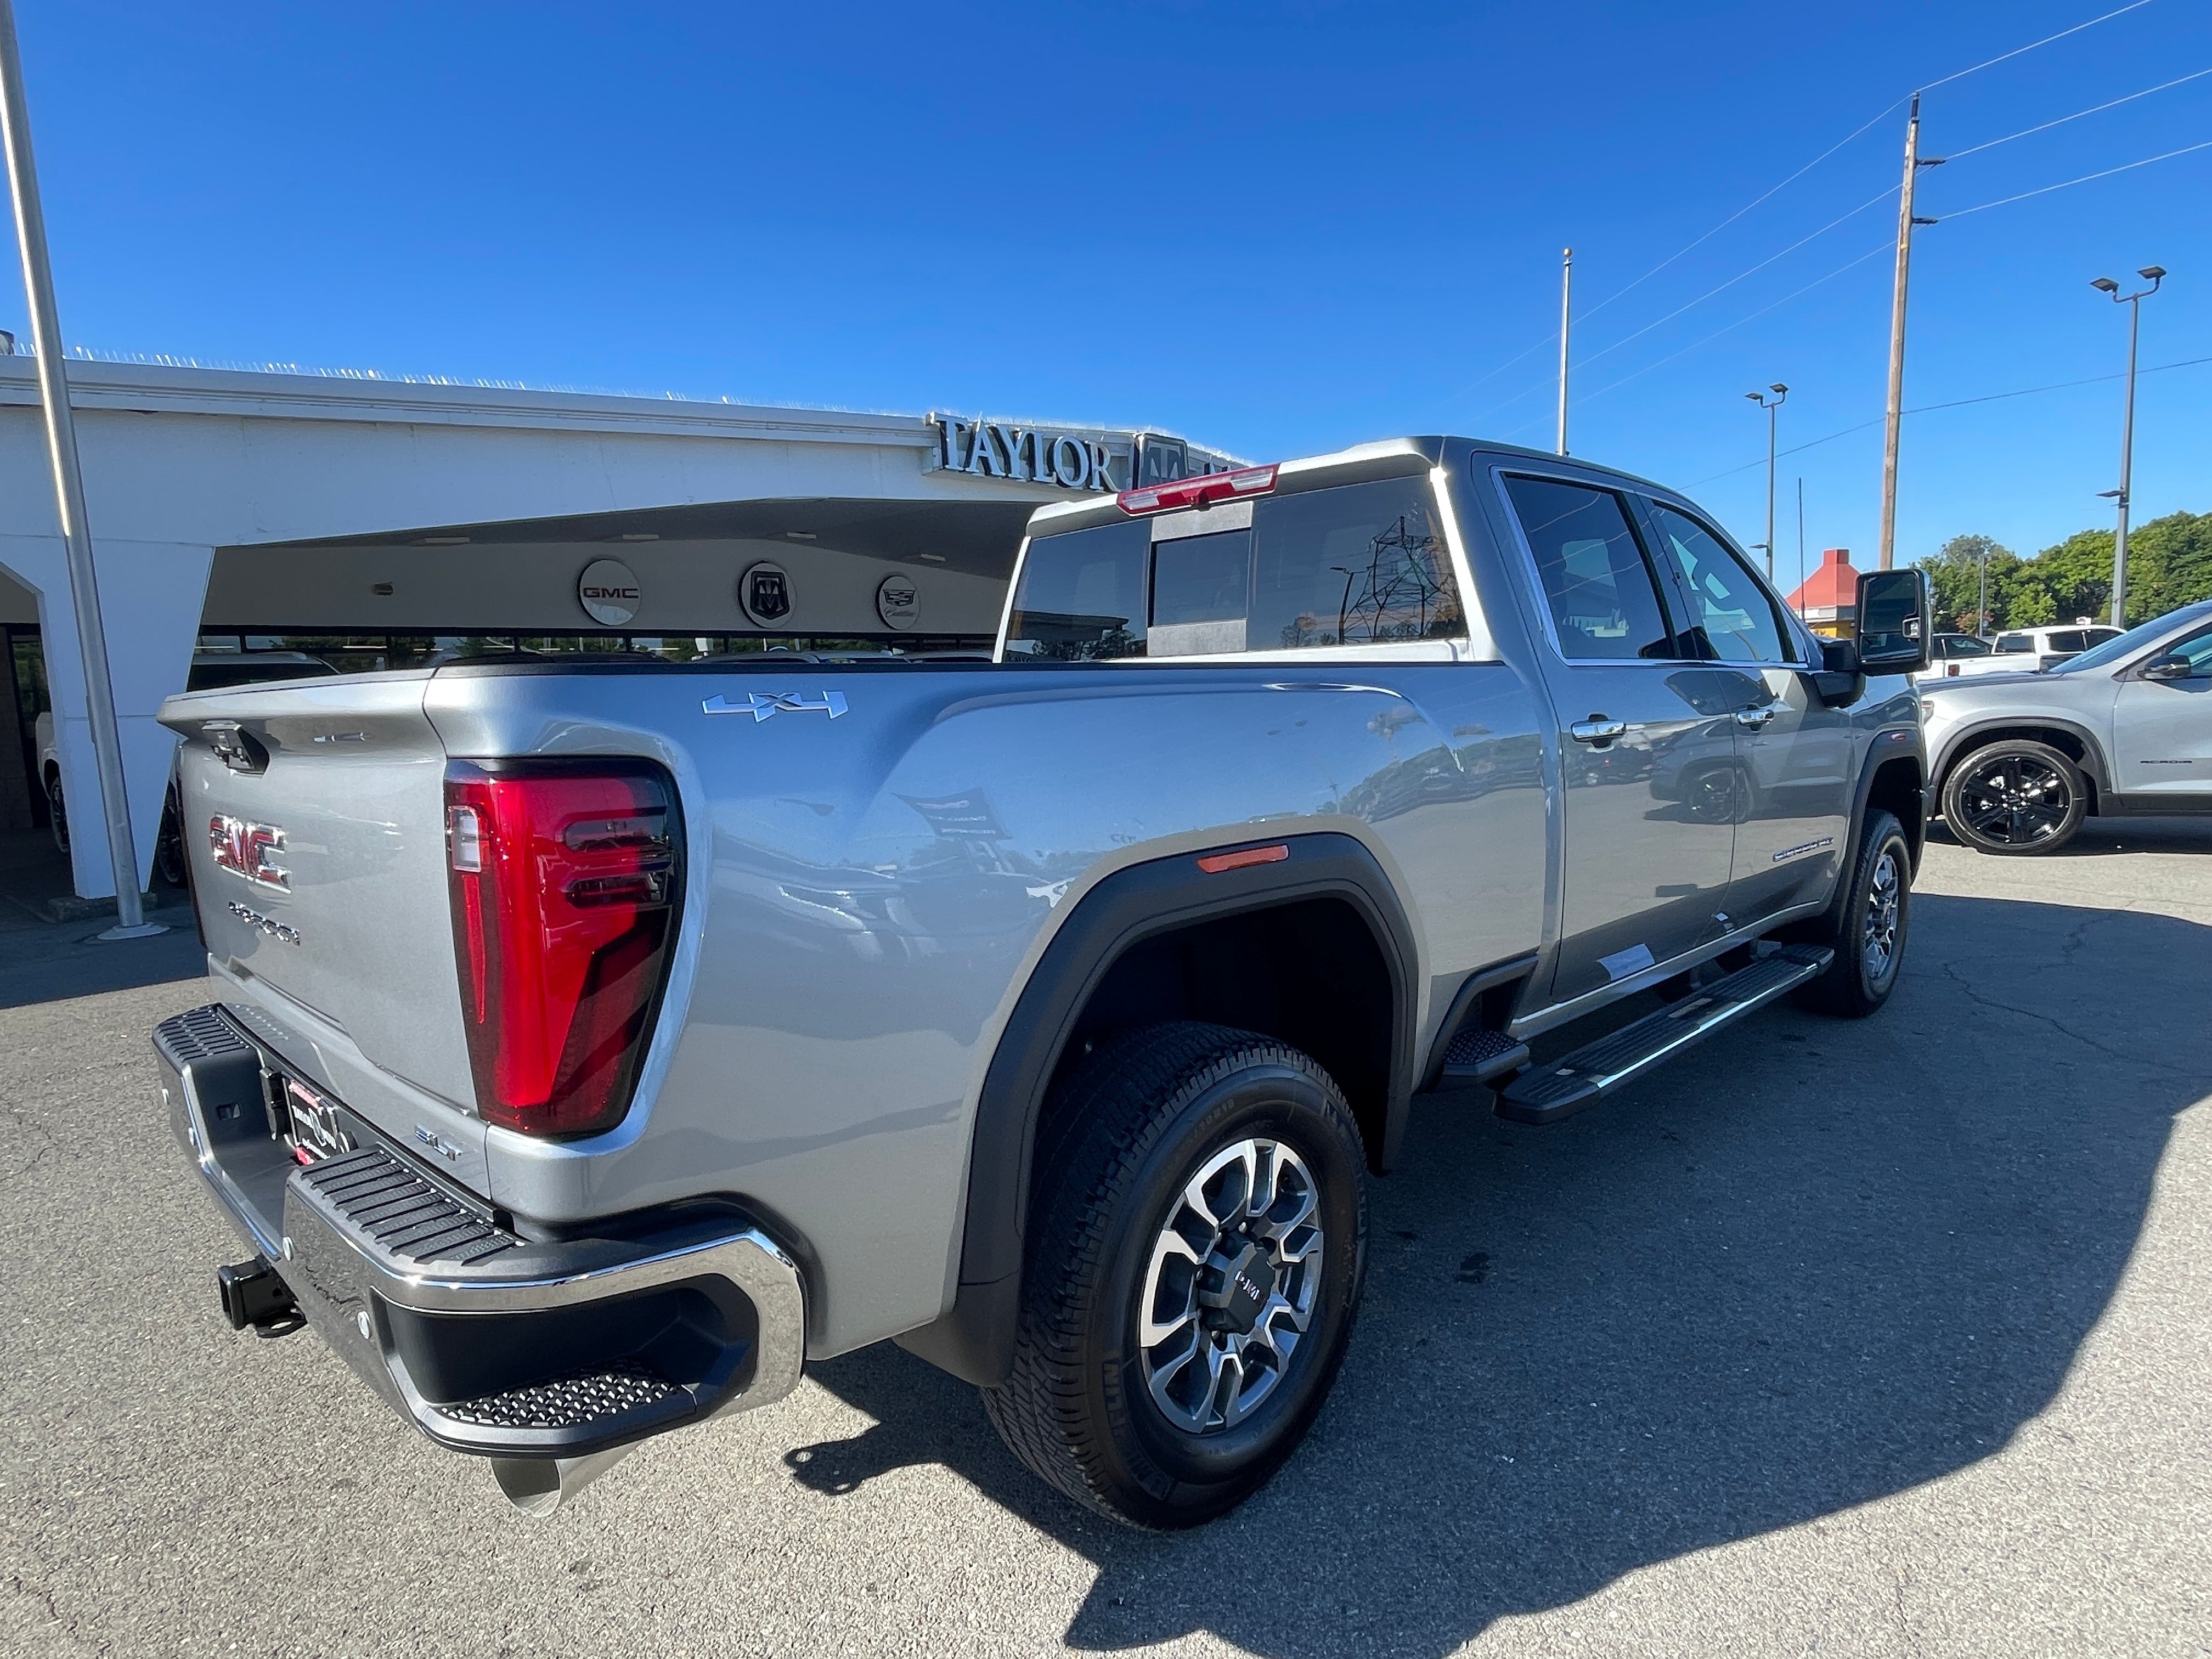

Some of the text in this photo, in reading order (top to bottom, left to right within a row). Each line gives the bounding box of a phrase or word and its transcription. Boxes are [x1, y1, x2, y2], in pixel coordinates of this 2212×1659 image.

[926, 411, 1121, 493] TAYLOR
[583, 587, 639, 599] GMC
[210, 812, 292, 894] GMC
